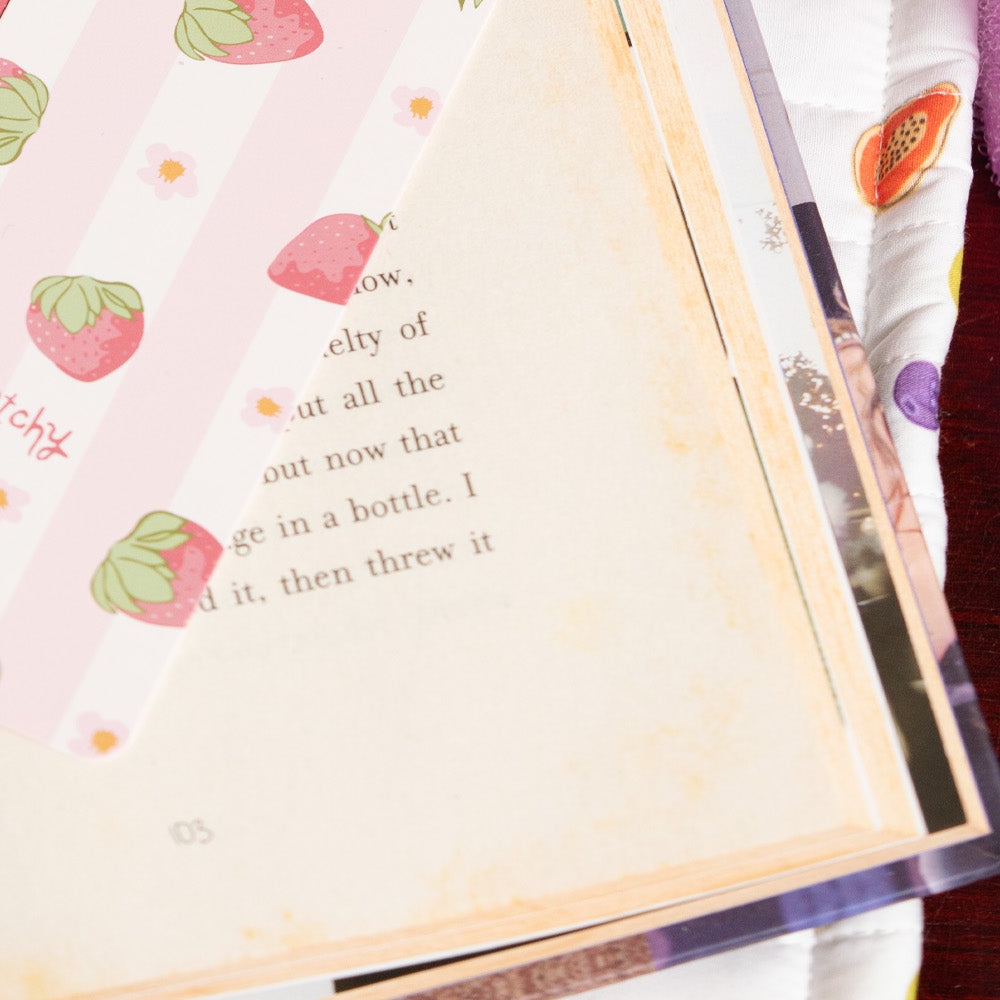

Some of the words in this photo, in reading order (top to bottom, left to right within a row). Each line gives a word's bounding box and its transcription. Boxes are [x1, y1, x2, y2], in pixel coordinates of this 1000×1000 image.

[400, 311, 428, 339] of
[344, 380, 380, 409] all
[395, 371, 443, 397] the
[325, 443, 385, 470] now
[399, 424, 461, 453] that
[278, 515, 311, 538] in
[323, 512, 339, 529] a
[347, 484, 451, 523] bottle.
[463, 472, 476, 497] I
[280, 567, 353, 595] then
[366, 544, 453, 576] threw
[471, 532, 493, 554] it
